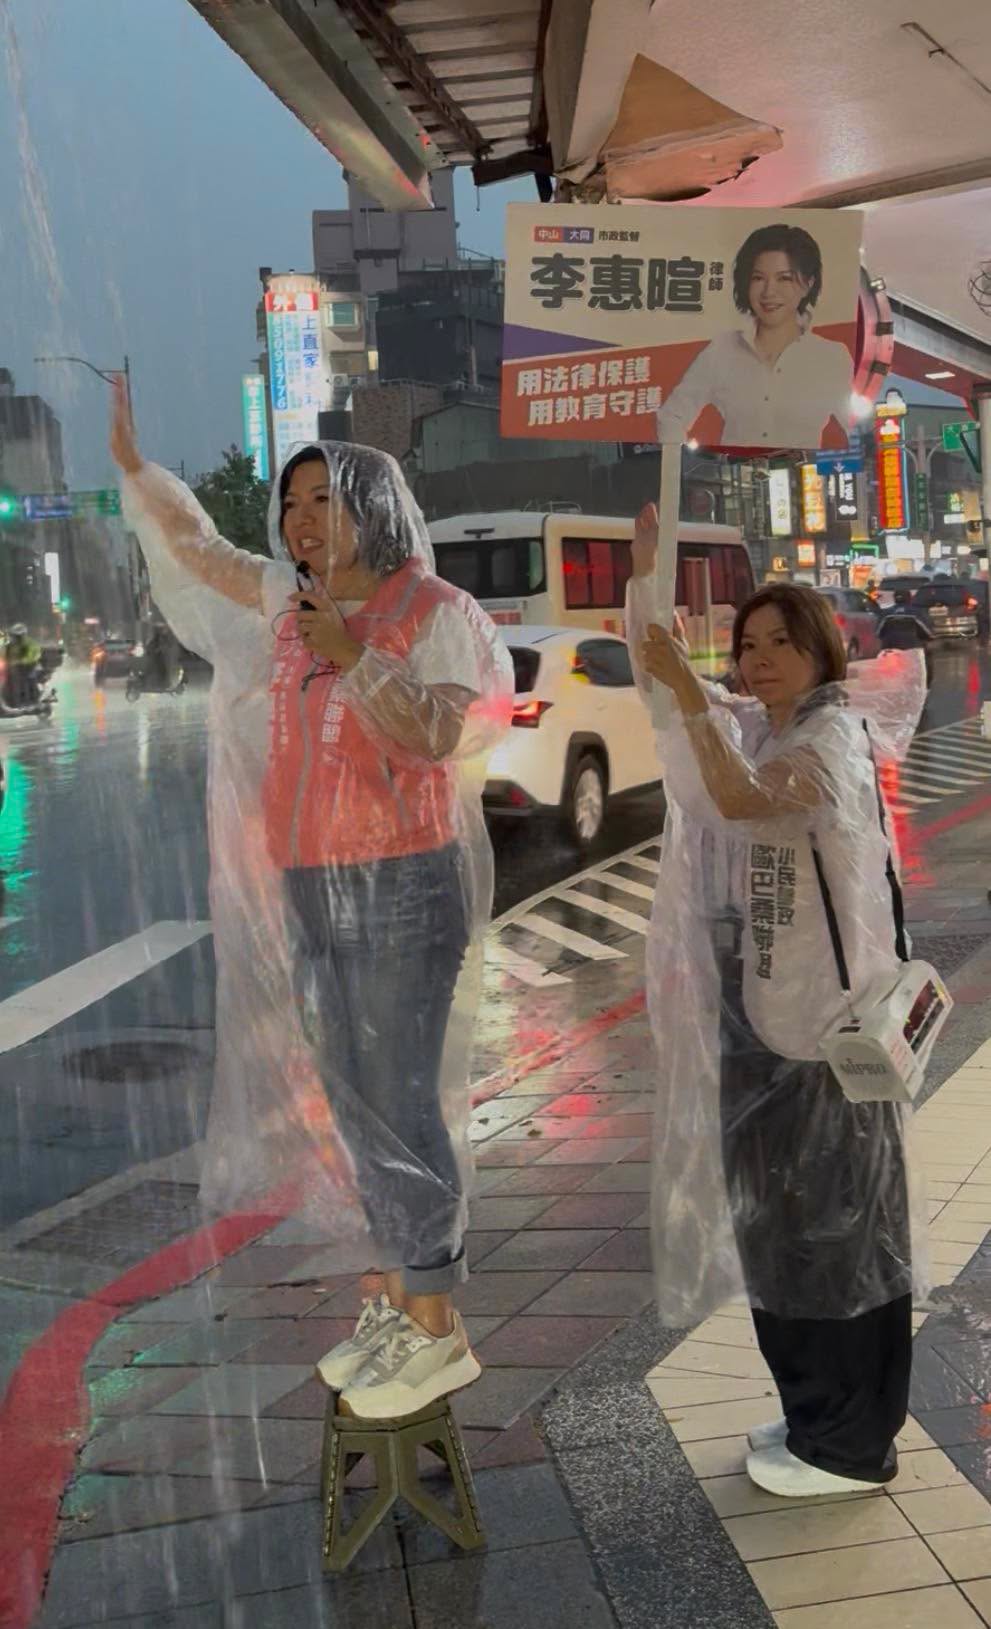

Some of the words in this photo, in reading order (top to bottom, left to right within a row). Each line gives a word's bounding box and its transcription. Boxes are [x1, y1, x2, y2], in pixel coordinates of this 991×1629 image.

[530, 252, 705, 312] 李惠暄
[708, 261, 724, 291] 律師
[516, 356, 651, 397] 用法律保護
[527, 385, 663, 427] 用教育守護
